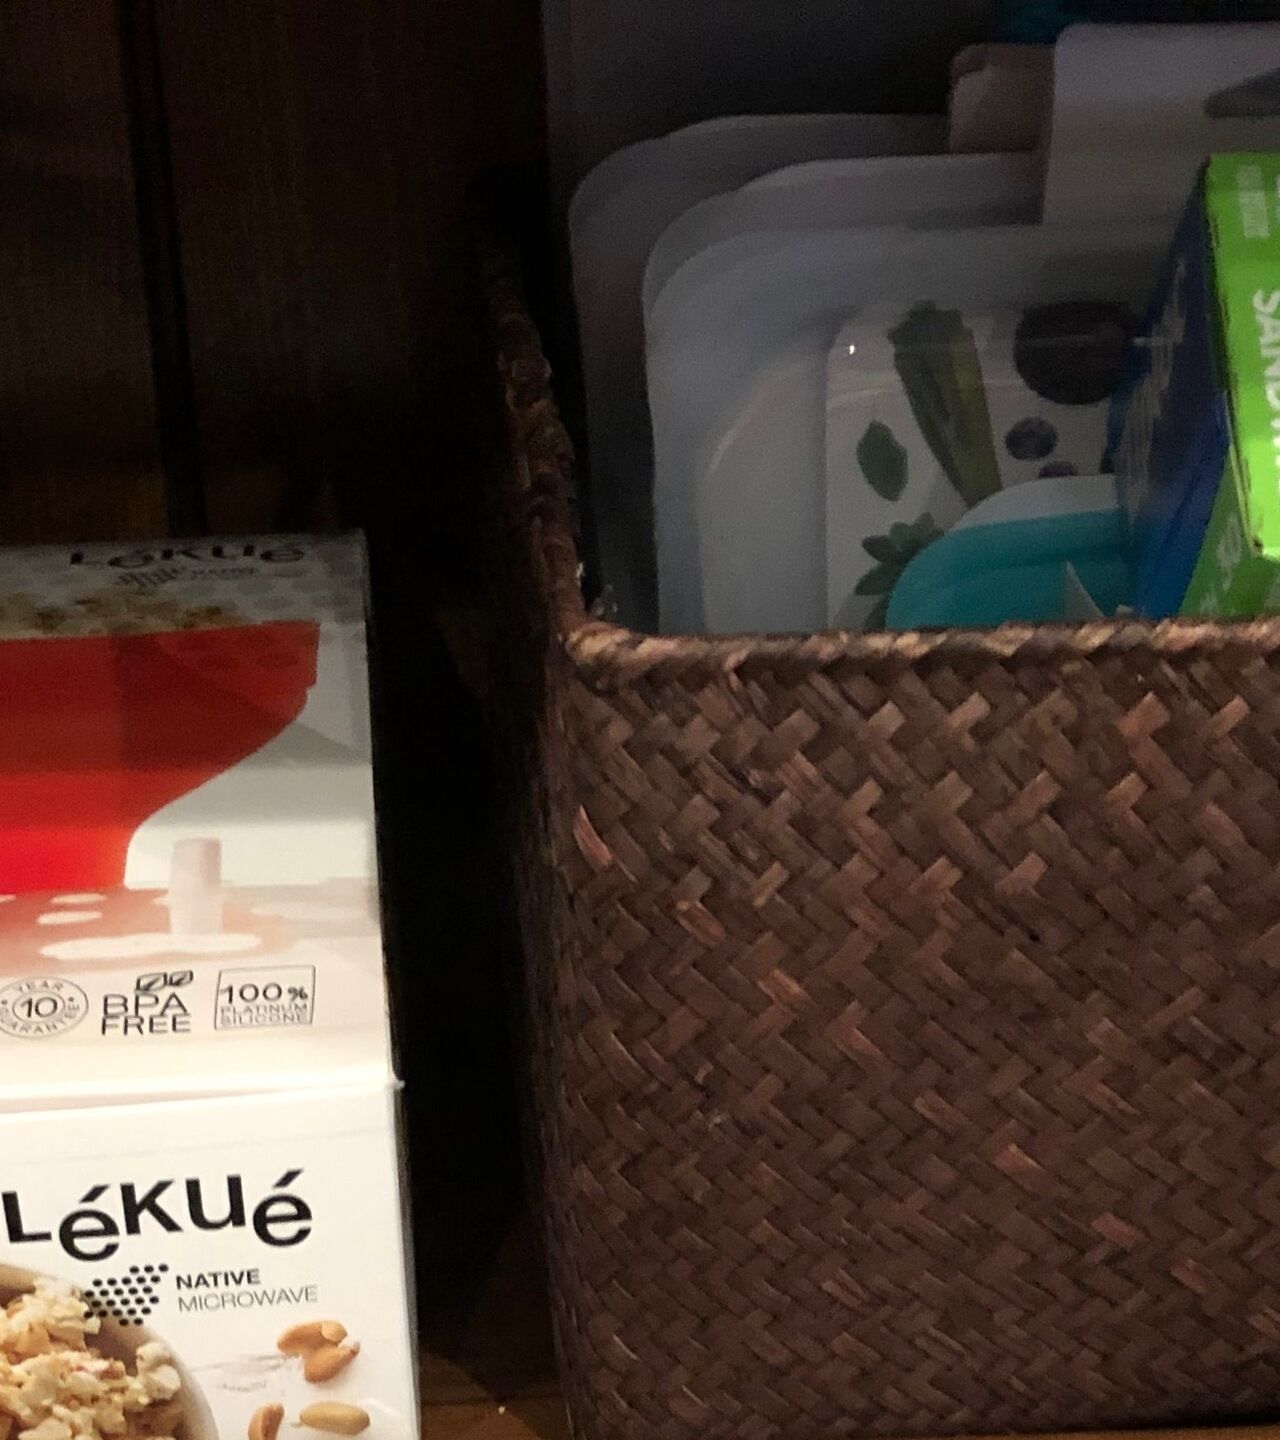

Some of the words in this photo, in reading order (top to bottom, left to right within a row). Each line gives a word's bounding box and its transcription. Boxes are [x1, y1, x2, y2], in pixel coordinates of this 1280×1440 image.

[19, 996, 58, 1019] 10
[103, 993, 189, 1017] BPA
[101, 1015, 191, 1036] FREE
[175, 1268, 261, 1290] NATIVE
[177, 1284, 319, 1313] MICROWAVE
